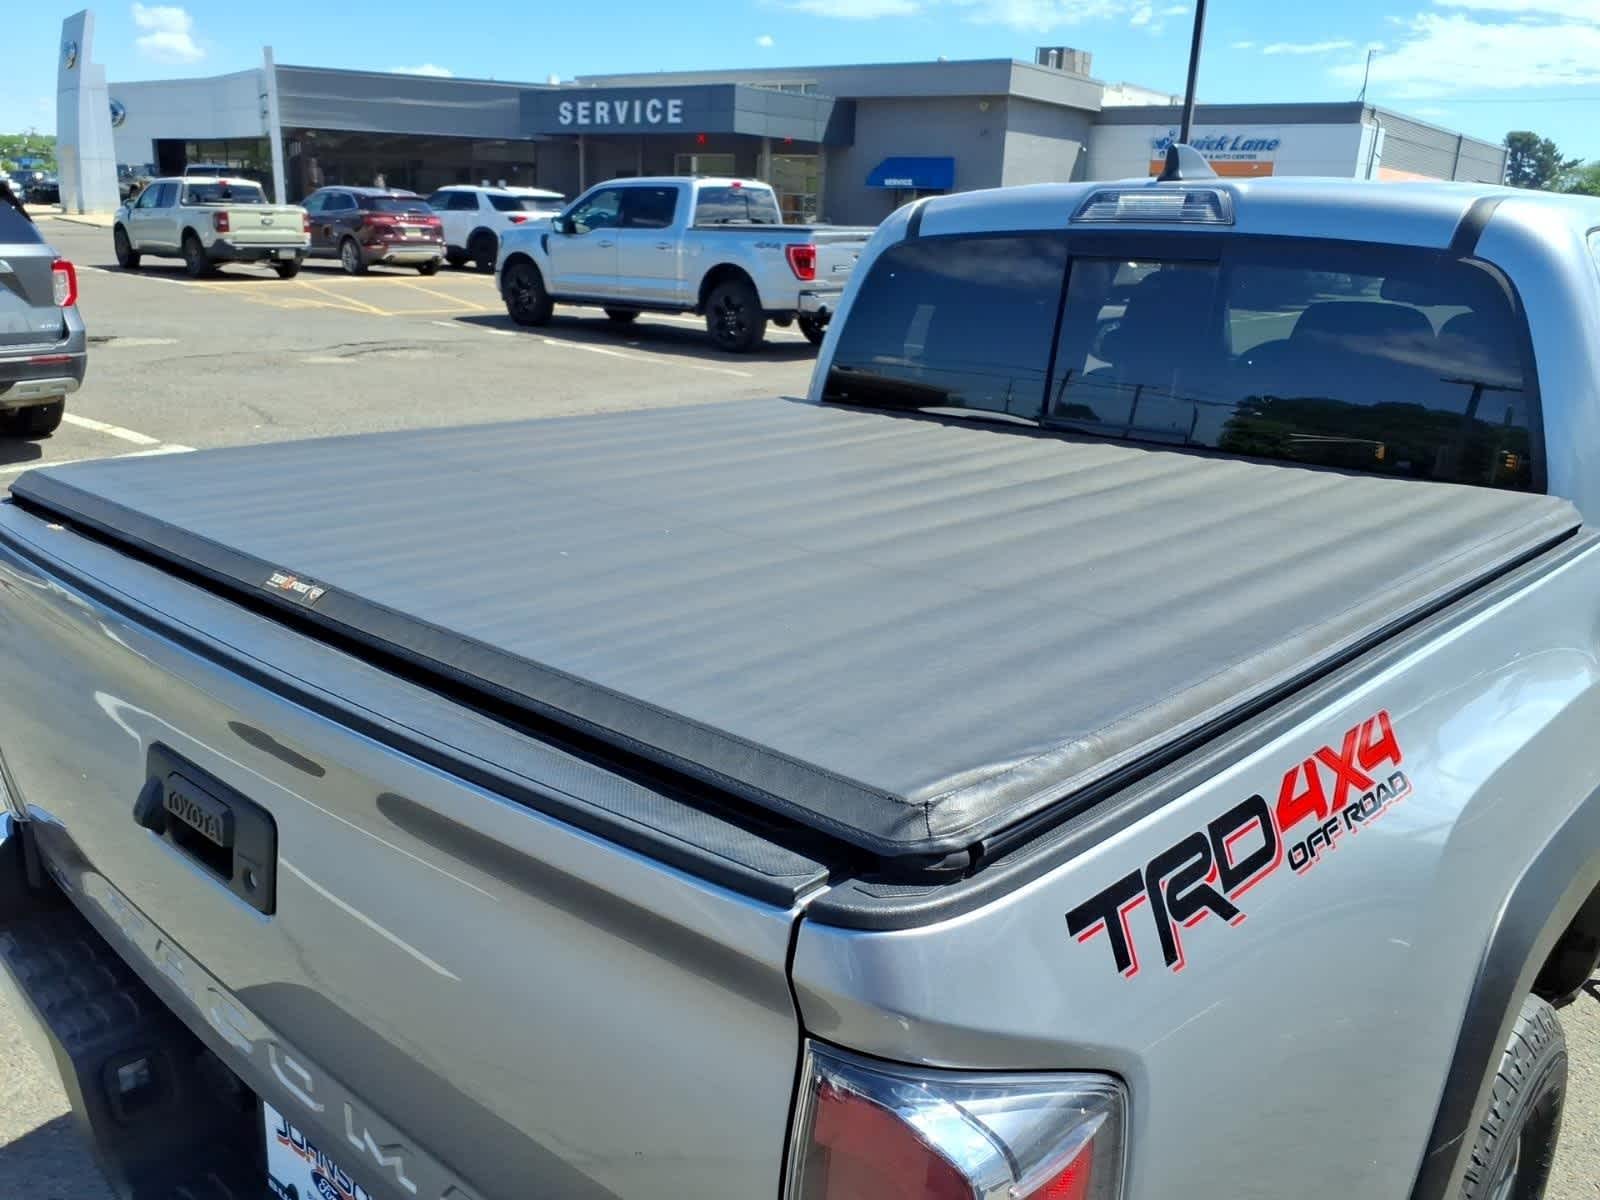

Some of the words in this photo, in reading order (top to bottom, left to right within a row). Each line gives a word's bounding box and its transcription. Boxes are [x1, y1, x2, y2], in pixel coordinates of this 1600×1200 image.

[558, 98, 684, 125] SERVICE
[1232, 135, 1281, 152] Lane
[166, 790, 225, 848] TOYOTA
[1287, 815, 1344, 875] OFF
[1343, 769, 1413, 835] ROAD
[1064, 793, 1284, 979] TRD
